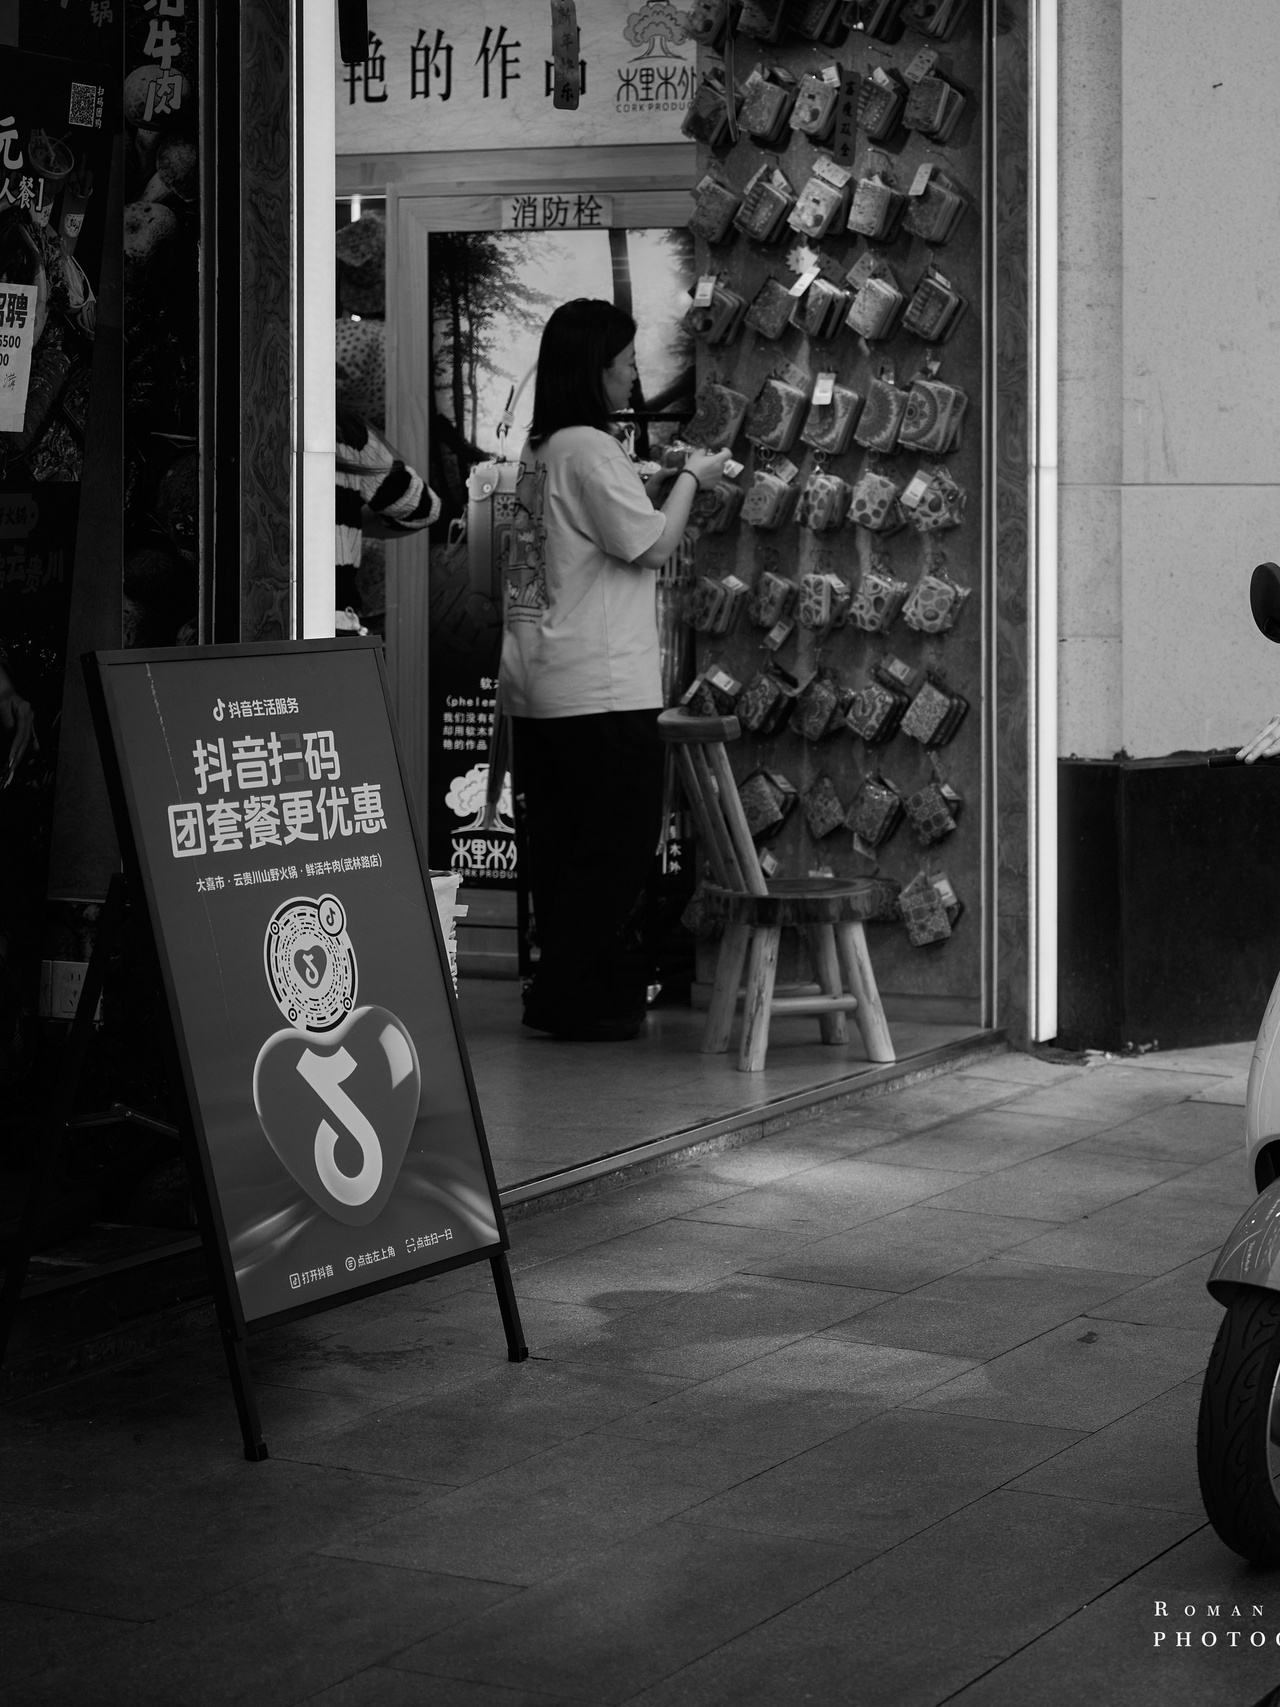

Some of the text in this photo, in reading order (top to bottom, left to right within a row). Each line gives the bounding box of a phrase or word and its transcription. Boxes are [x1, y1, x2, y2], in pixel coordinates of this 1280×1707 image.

[511, 194, 603, 229] 消防栓
[0, 545, 64, 594] 云贵川
[229, 697, 299, 719] 抖音生活服务
[193, 730, 341, 795] 抖音扫码
[167, 782, 388, 858] 团套餐更优惠
[301, 1228, 453, 1284] 打开抖音 点击左上角 点击扫一扫
